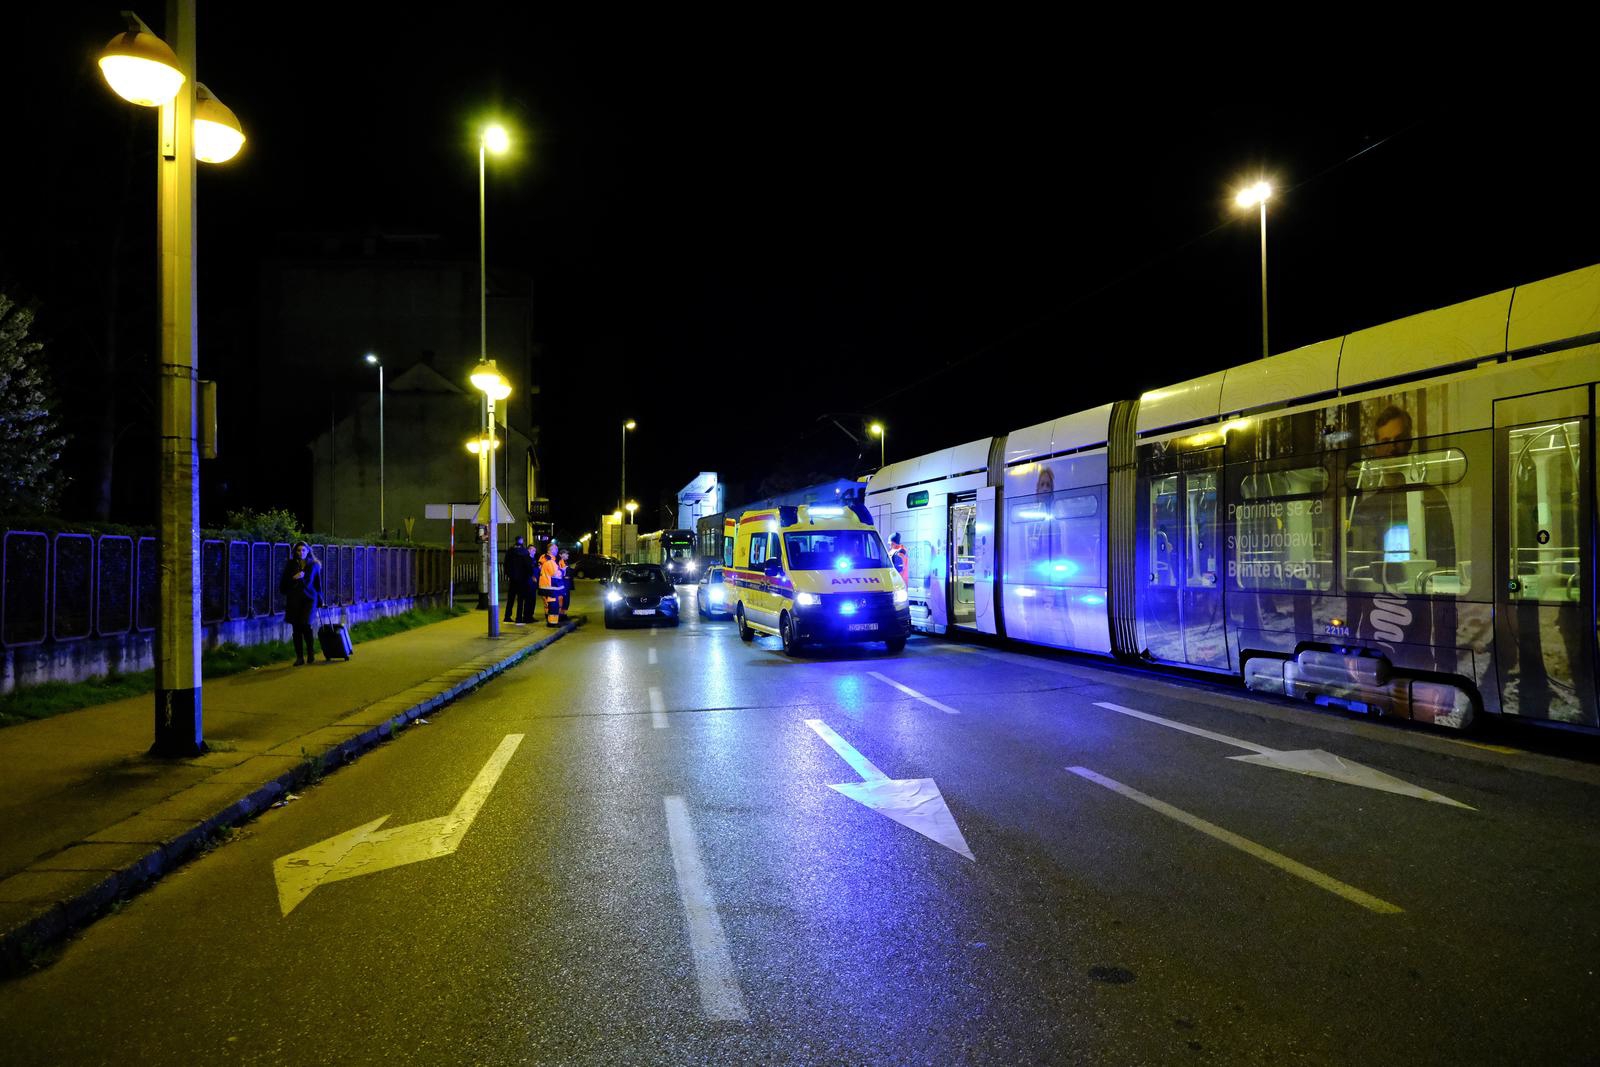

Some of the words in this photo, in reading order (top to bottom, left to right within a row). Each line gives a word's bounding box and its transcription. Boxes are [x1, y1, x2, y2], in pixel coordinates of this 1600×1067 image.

[1227, 499, 1283, 520] Pobrinite
[1286, 502, 1303, 516] se
[1305, 498, 1323, 515] za
[1227, 530, 1259, 553] svoju
[1262, 528, 1321, 552] probavu.
[1228, 558, 1271, 577] Brinite
[1285, 558, 1321, 578] sebi.
[1325, 625, 1350, 636] 22114
